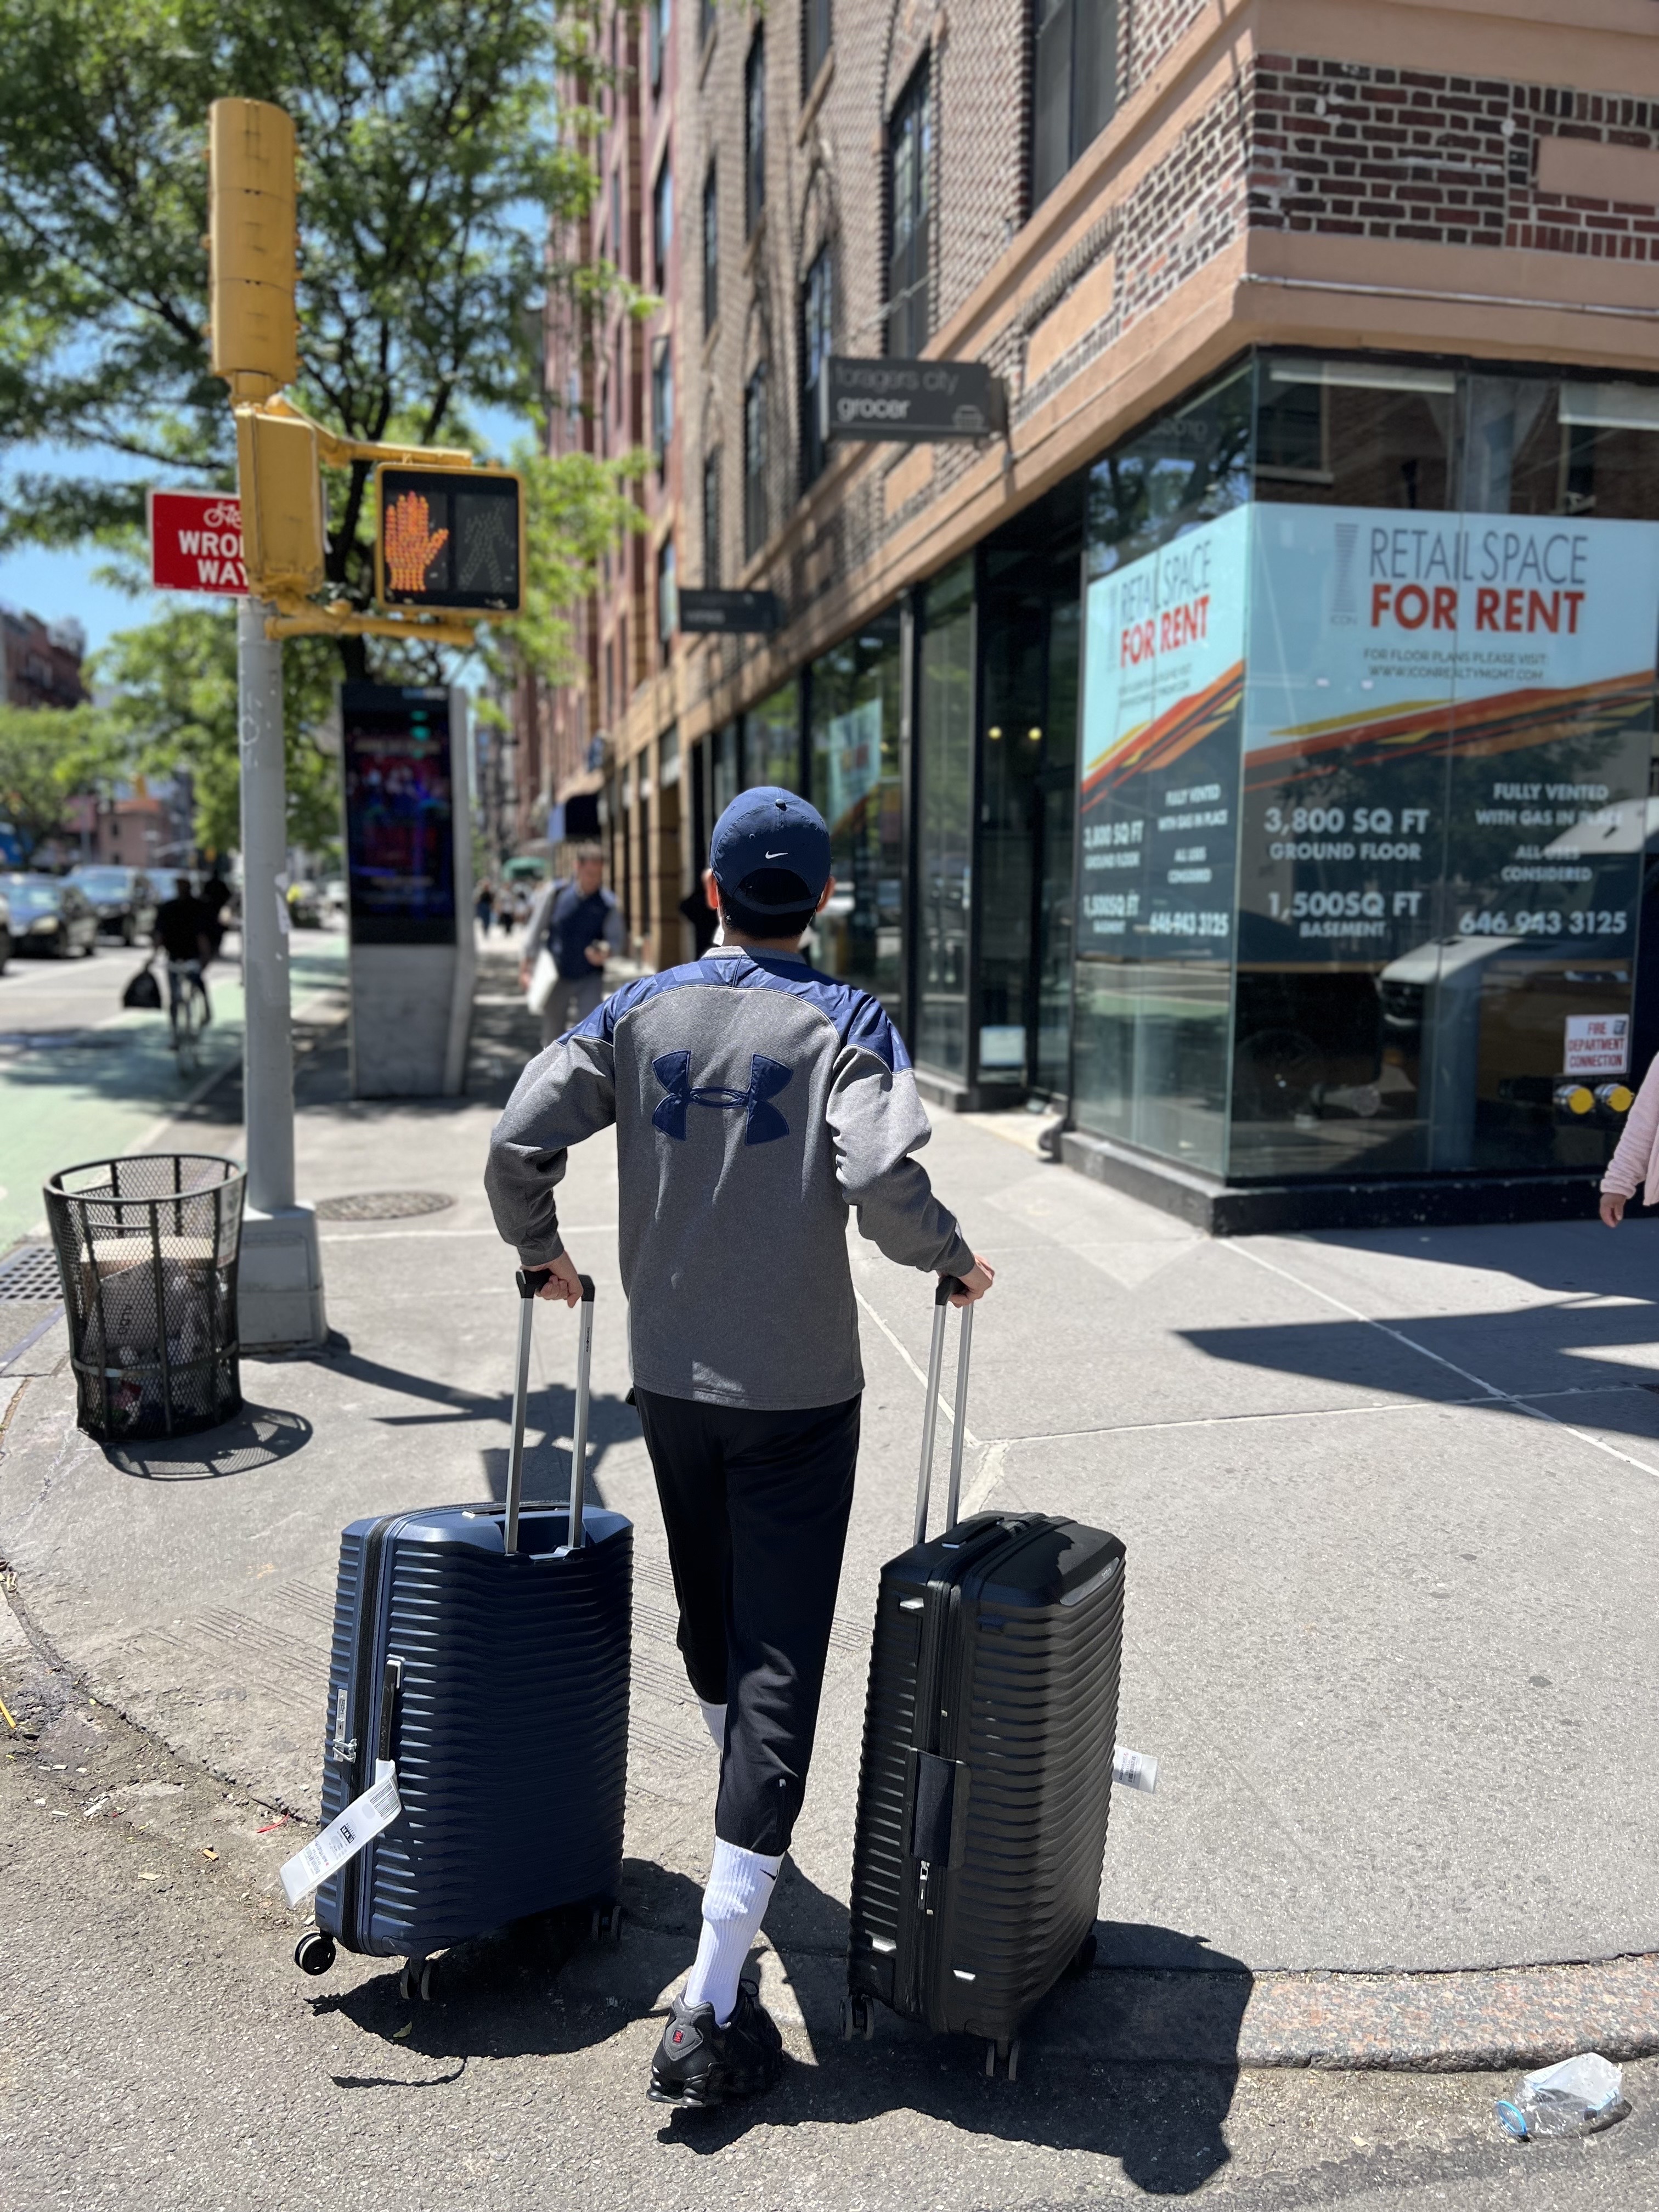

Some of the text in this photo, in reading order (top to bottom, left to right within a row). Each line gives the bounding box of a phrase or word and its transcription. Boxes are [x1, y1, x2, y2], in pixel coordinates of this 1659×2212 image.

[923, 368, 960, 396] city
[837, 397, 911, 422] grocer
[178, 530, 244, 558] WRO
[1370, 528, 1588, 584] RETAIL SPACE
[1372, 584, 1585, 634] FOR RENT
[1120, 594, 1211, 668] FOR RENT
[1364, 649, 1389, 660] FOR
[1390, 650, 1429, 662] FLOOR
[1431, 651, 1470, 664] PLANS
[1472, 652, 1517, 665] PLEASE
[1493, 783, 1610, 802] FULLY VENTED
[1264, 808, 1430, 836] 3,800 SQ FT
[1475, 809, 1518, 826] WITH
[1519, 809, 1554, 826] GAS
[1556, 810, 1577, 826] IN
[1269, 842, 1421, 861] GROUND FLOOR
[1515, 845, 1542, 861] ALL
[1500, 866, 1593, 883] CONSIDERED
[1392, 891, 1423, 917] FT
[1299, 921, 1387, 938] BASEMENT
[1458, 911, 1628, 935] 646 943 3125
[1587, 1022, 1607, 1035] FIRE
[1567, 1037, 1625, 1052] DEPARTMENT
[1569, 1054, 1623, 1068] CONNECTION
[341, 1826, 354, 1842] EWR
